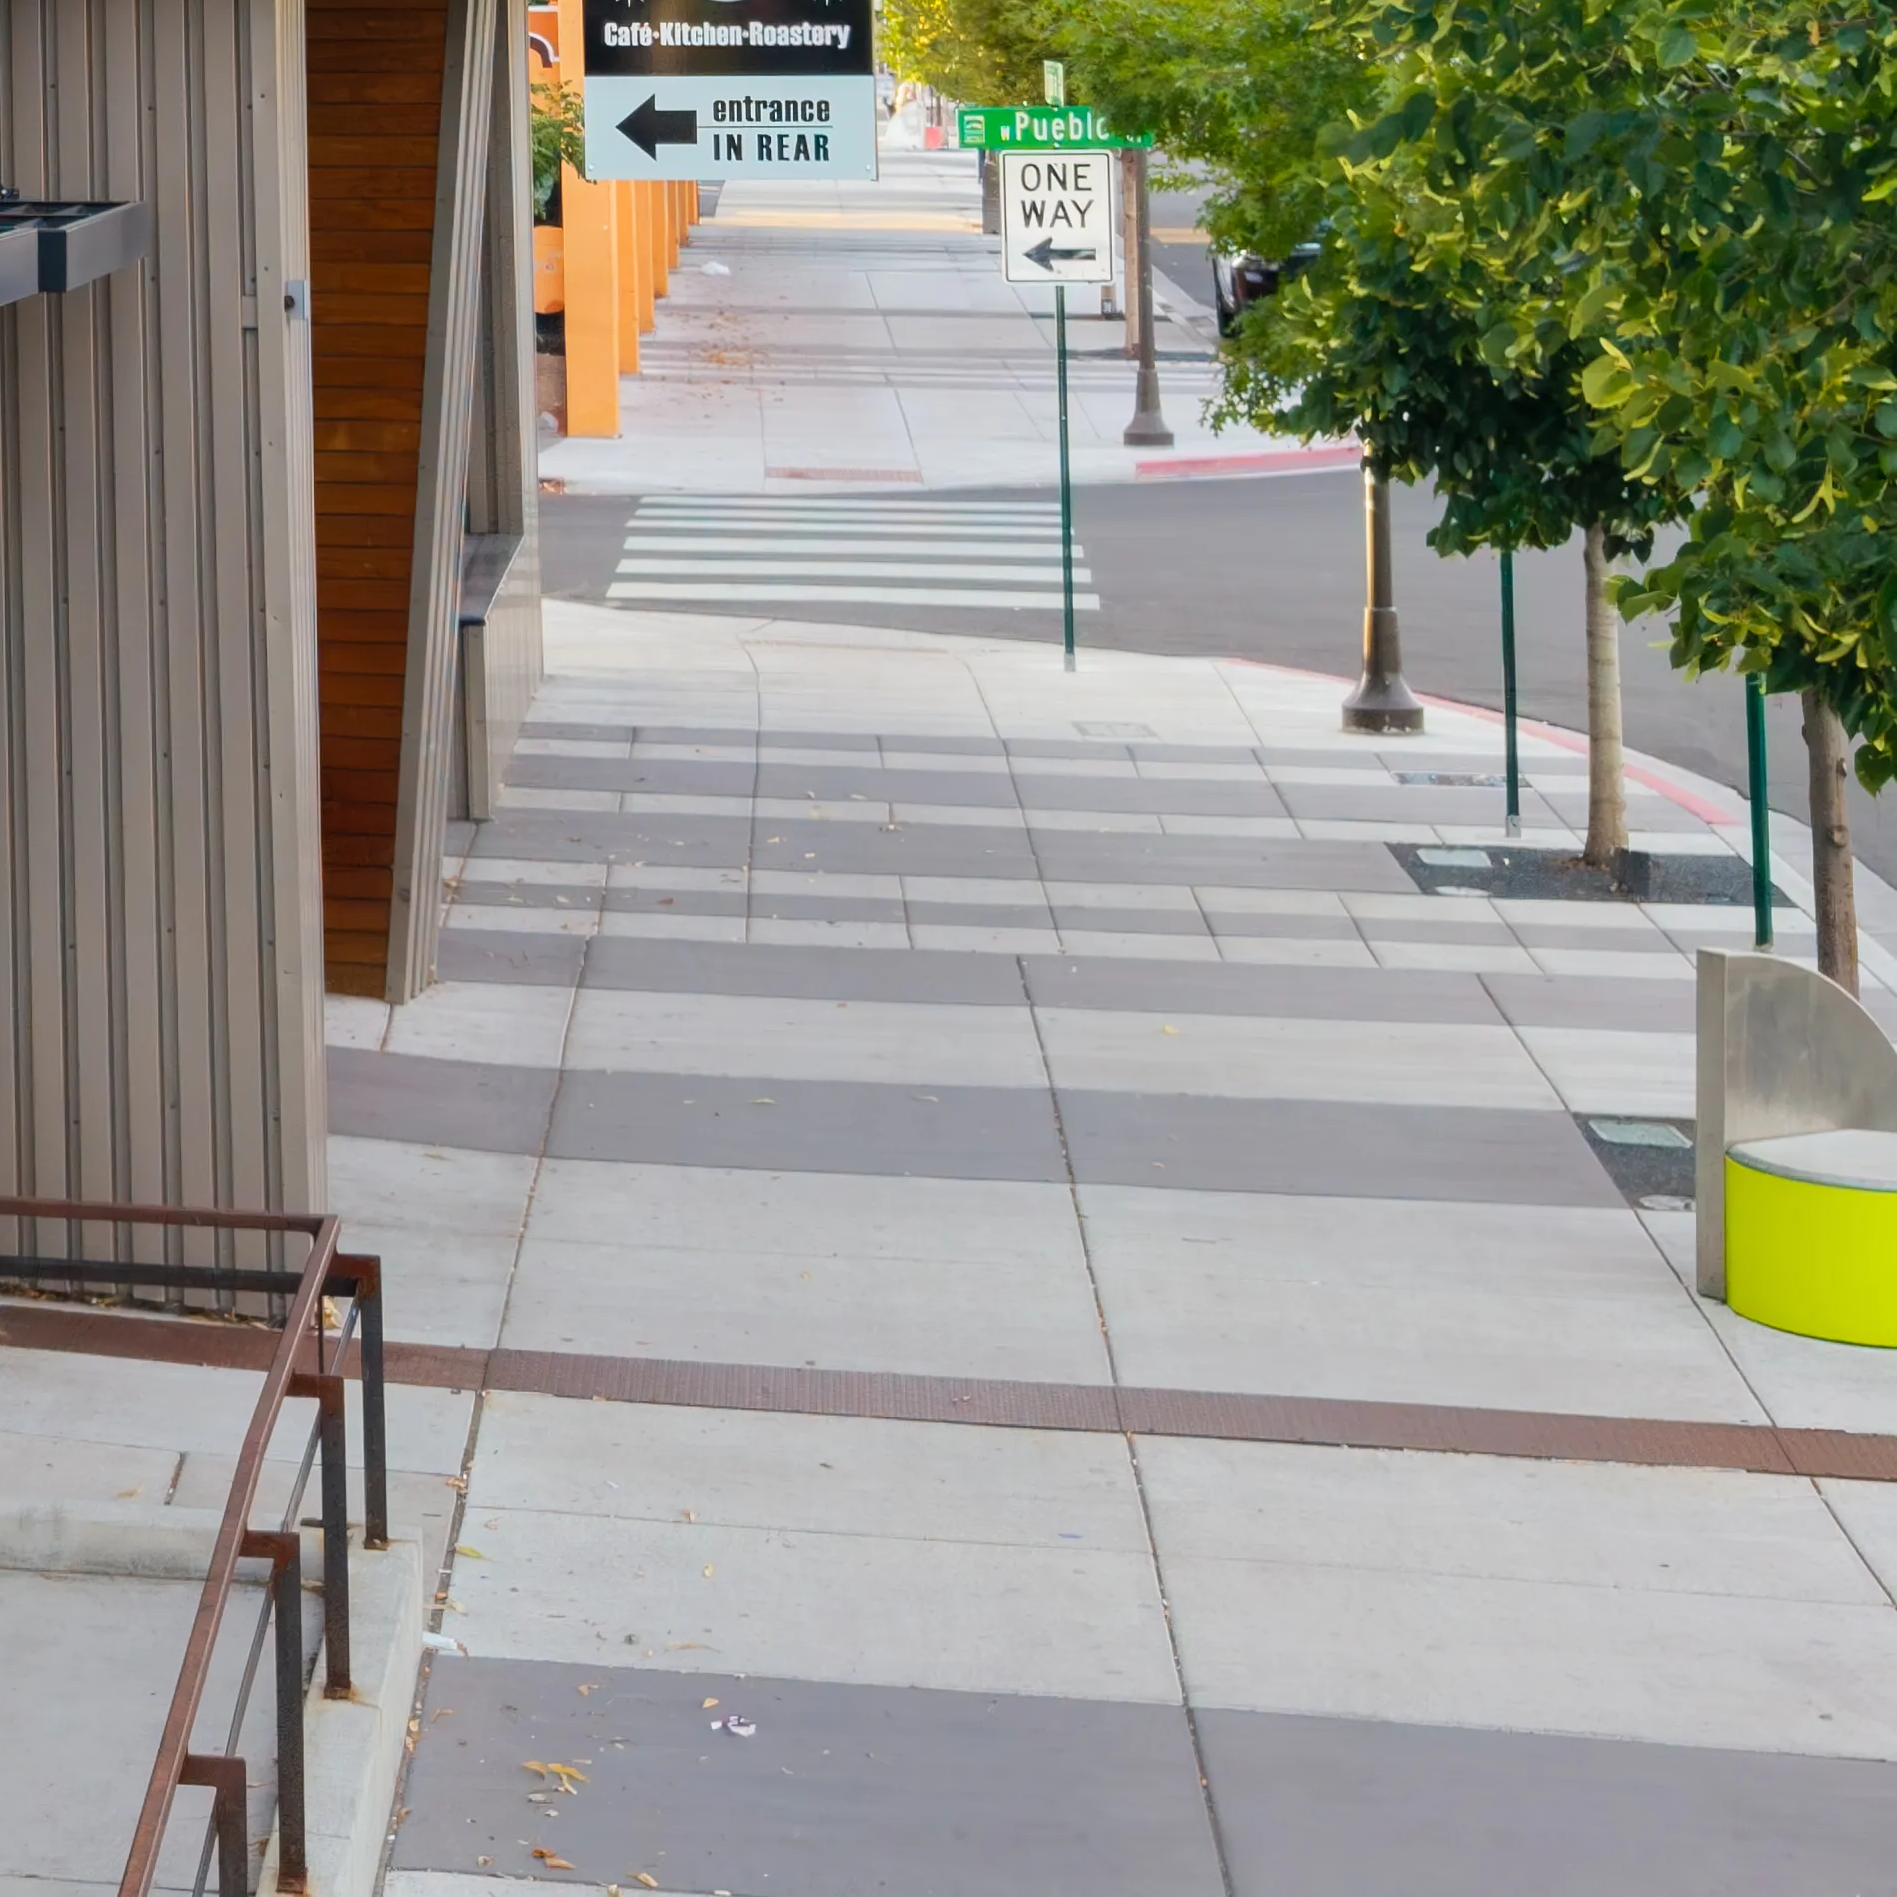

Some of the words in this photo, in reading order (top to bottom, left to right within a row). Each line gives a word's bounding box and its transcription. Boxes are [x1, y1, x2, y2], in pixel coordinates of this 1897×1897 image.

[713, 96, 830, 122] entrance
[713, 134, 743, 161] IN
[757, 134, 830, 161] REAR
[1021, 163, 1092, 191] ONE
[1020, 200, 1094, 228] WAY
